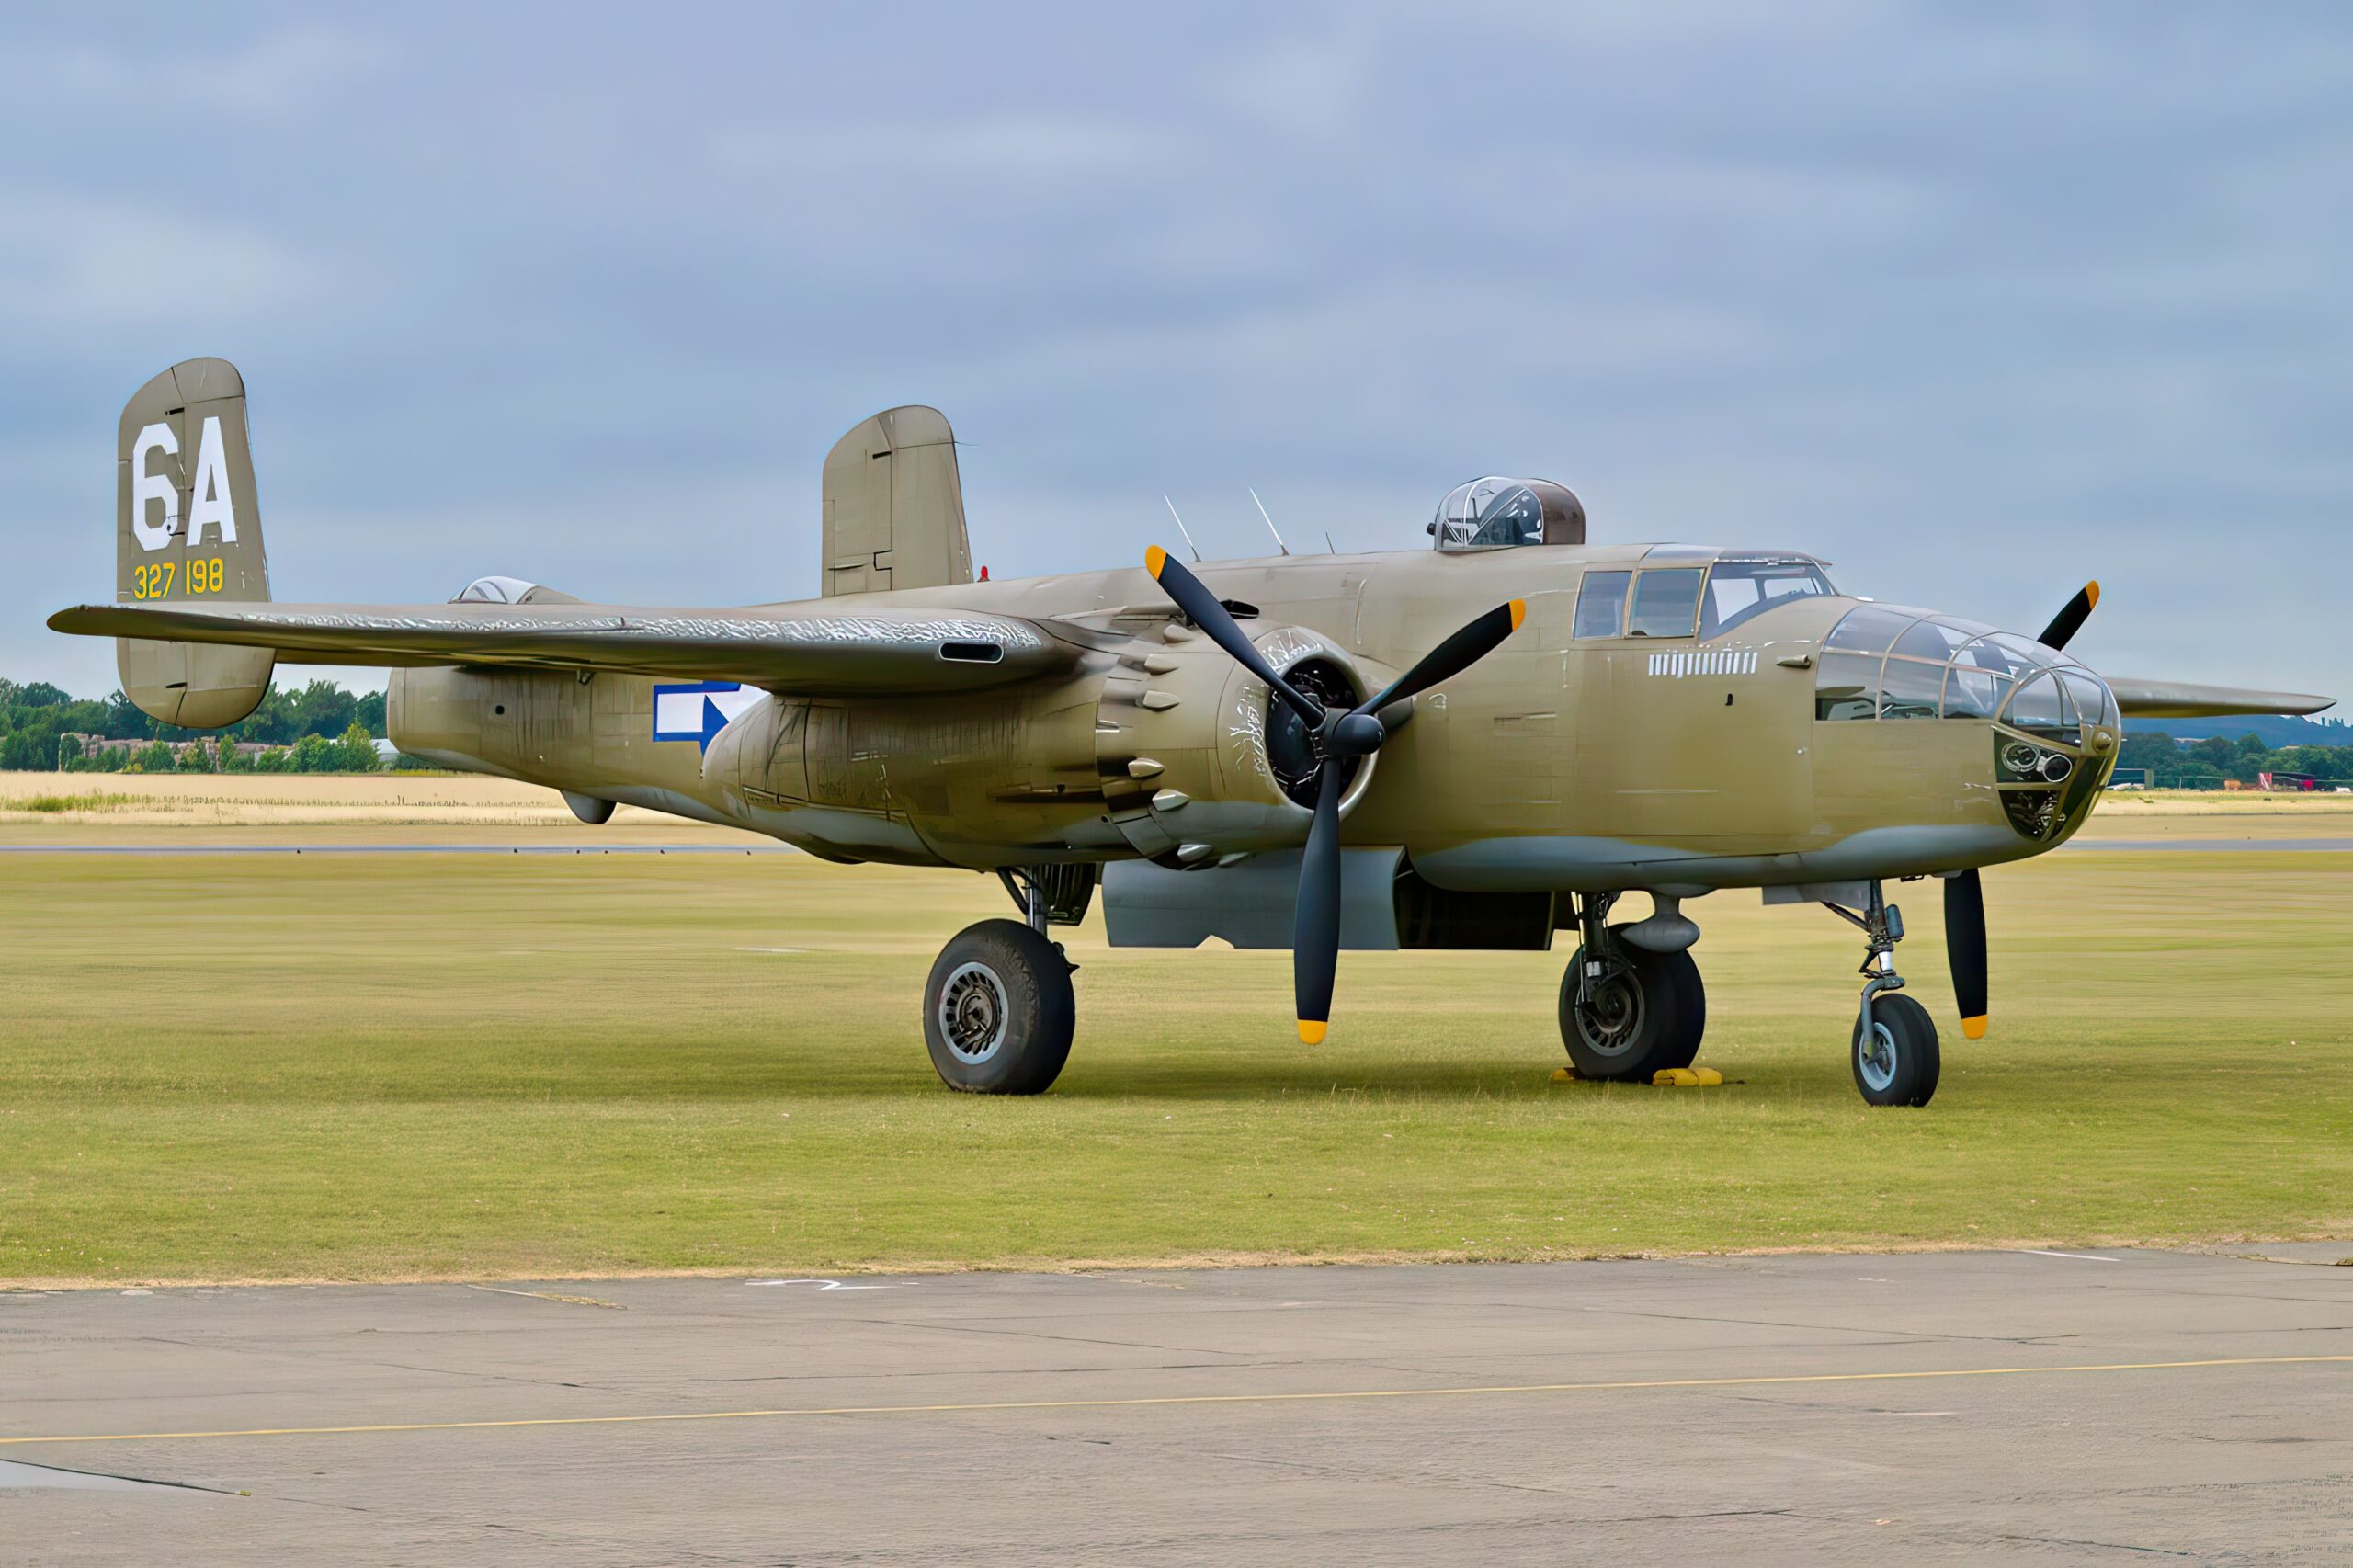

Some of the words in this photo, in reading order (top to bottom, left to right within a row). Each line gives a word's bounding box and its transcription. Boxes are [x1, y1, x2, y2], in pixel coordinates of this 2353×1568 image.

[133, 415, 237, 551] 6A
[133, 562, 176, 599] 327
[186, 557, 224, 595] 198
